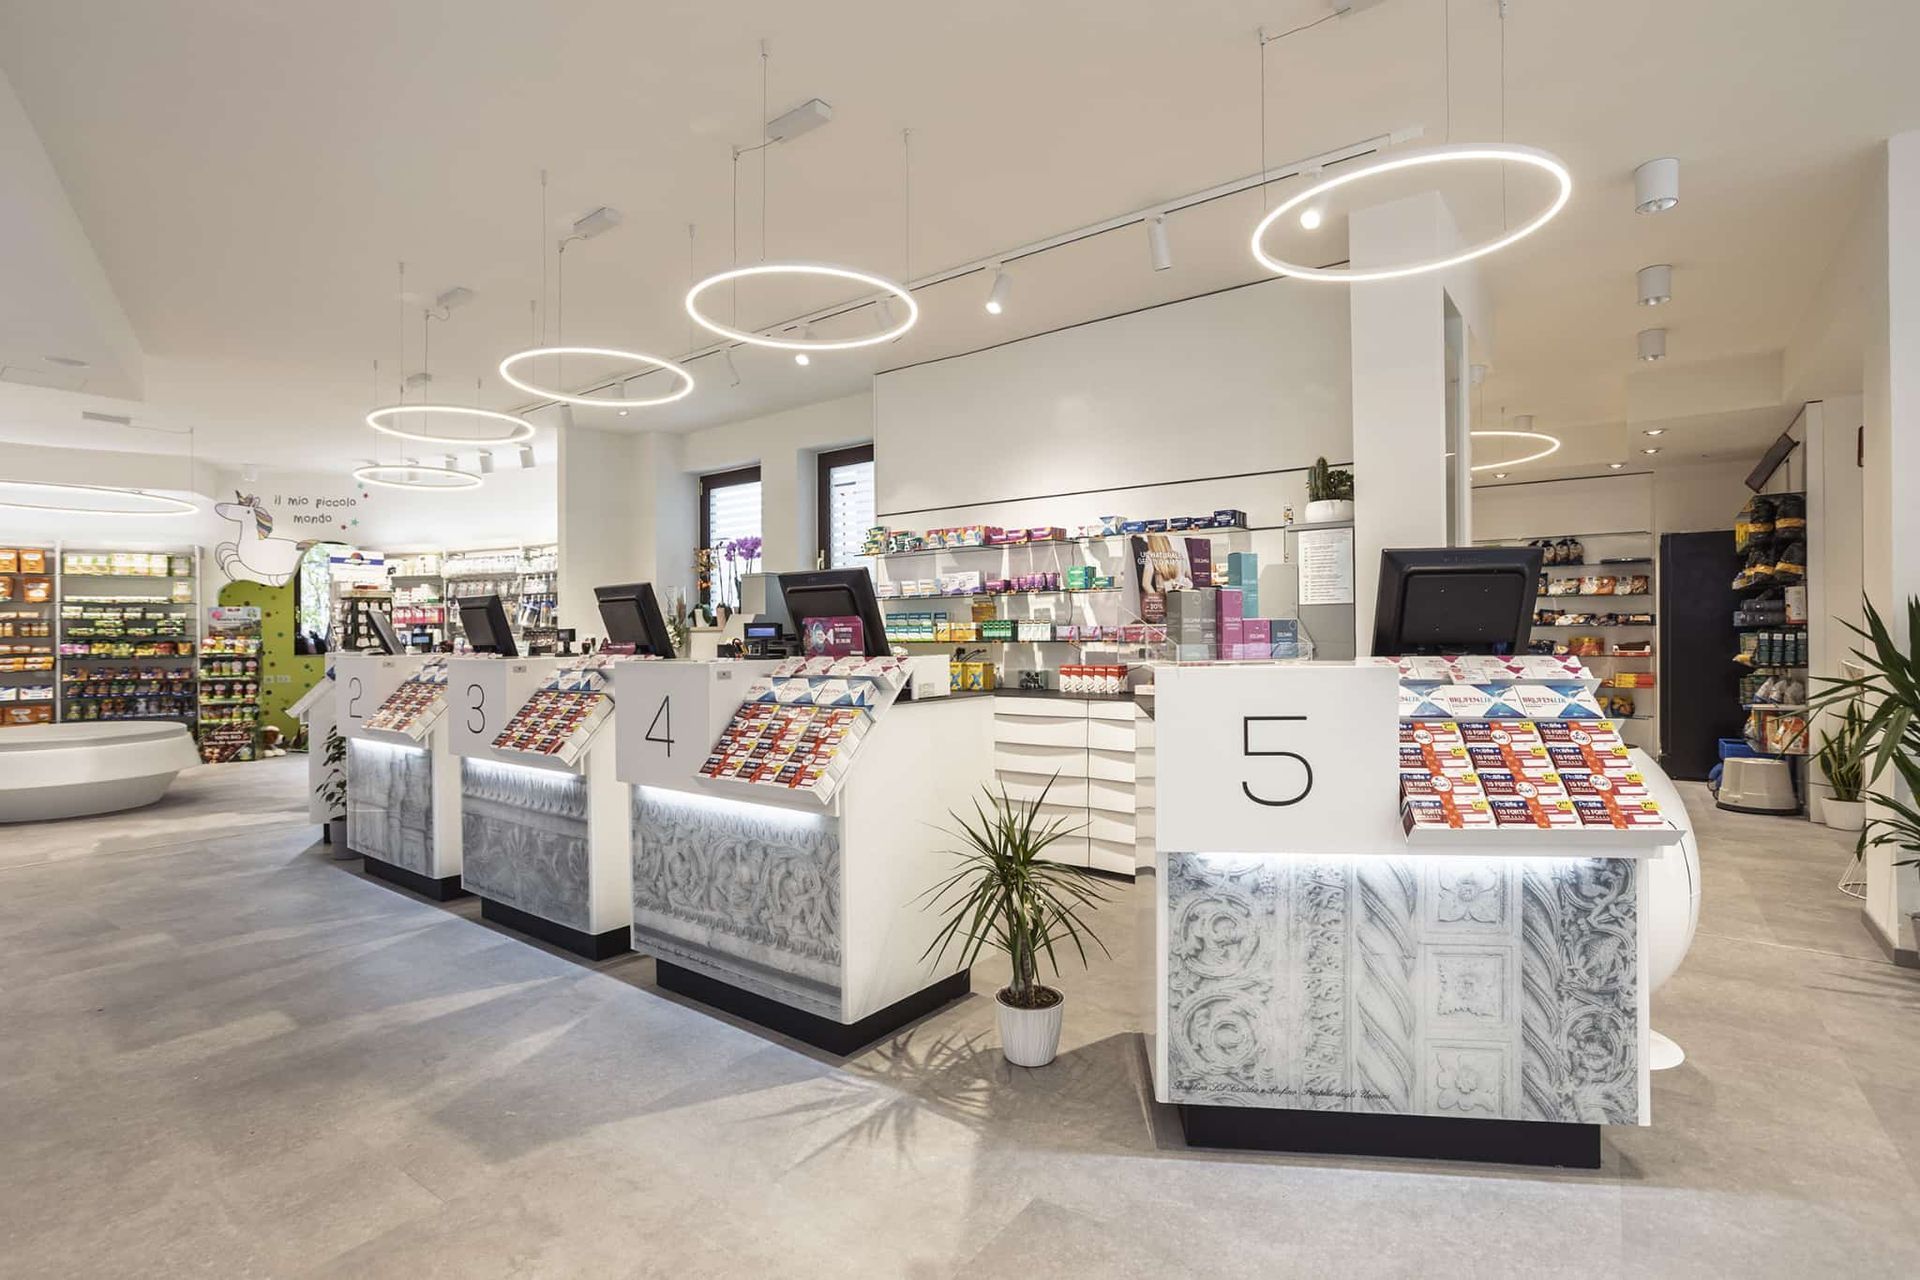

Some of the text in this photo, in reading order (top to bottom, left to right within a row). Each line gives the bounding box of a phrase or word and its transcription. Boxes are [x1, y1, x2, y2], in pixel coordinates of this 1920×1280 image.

[274, 494, 357, 509] il mio piccolo
[293, 513, 332, 524] mondo
[348, 676, 363, 719] 2
[466, 683, 486, 735] 3
[645, 695, 675, 758] 4
[1241, 715, 1313, 807] 5
